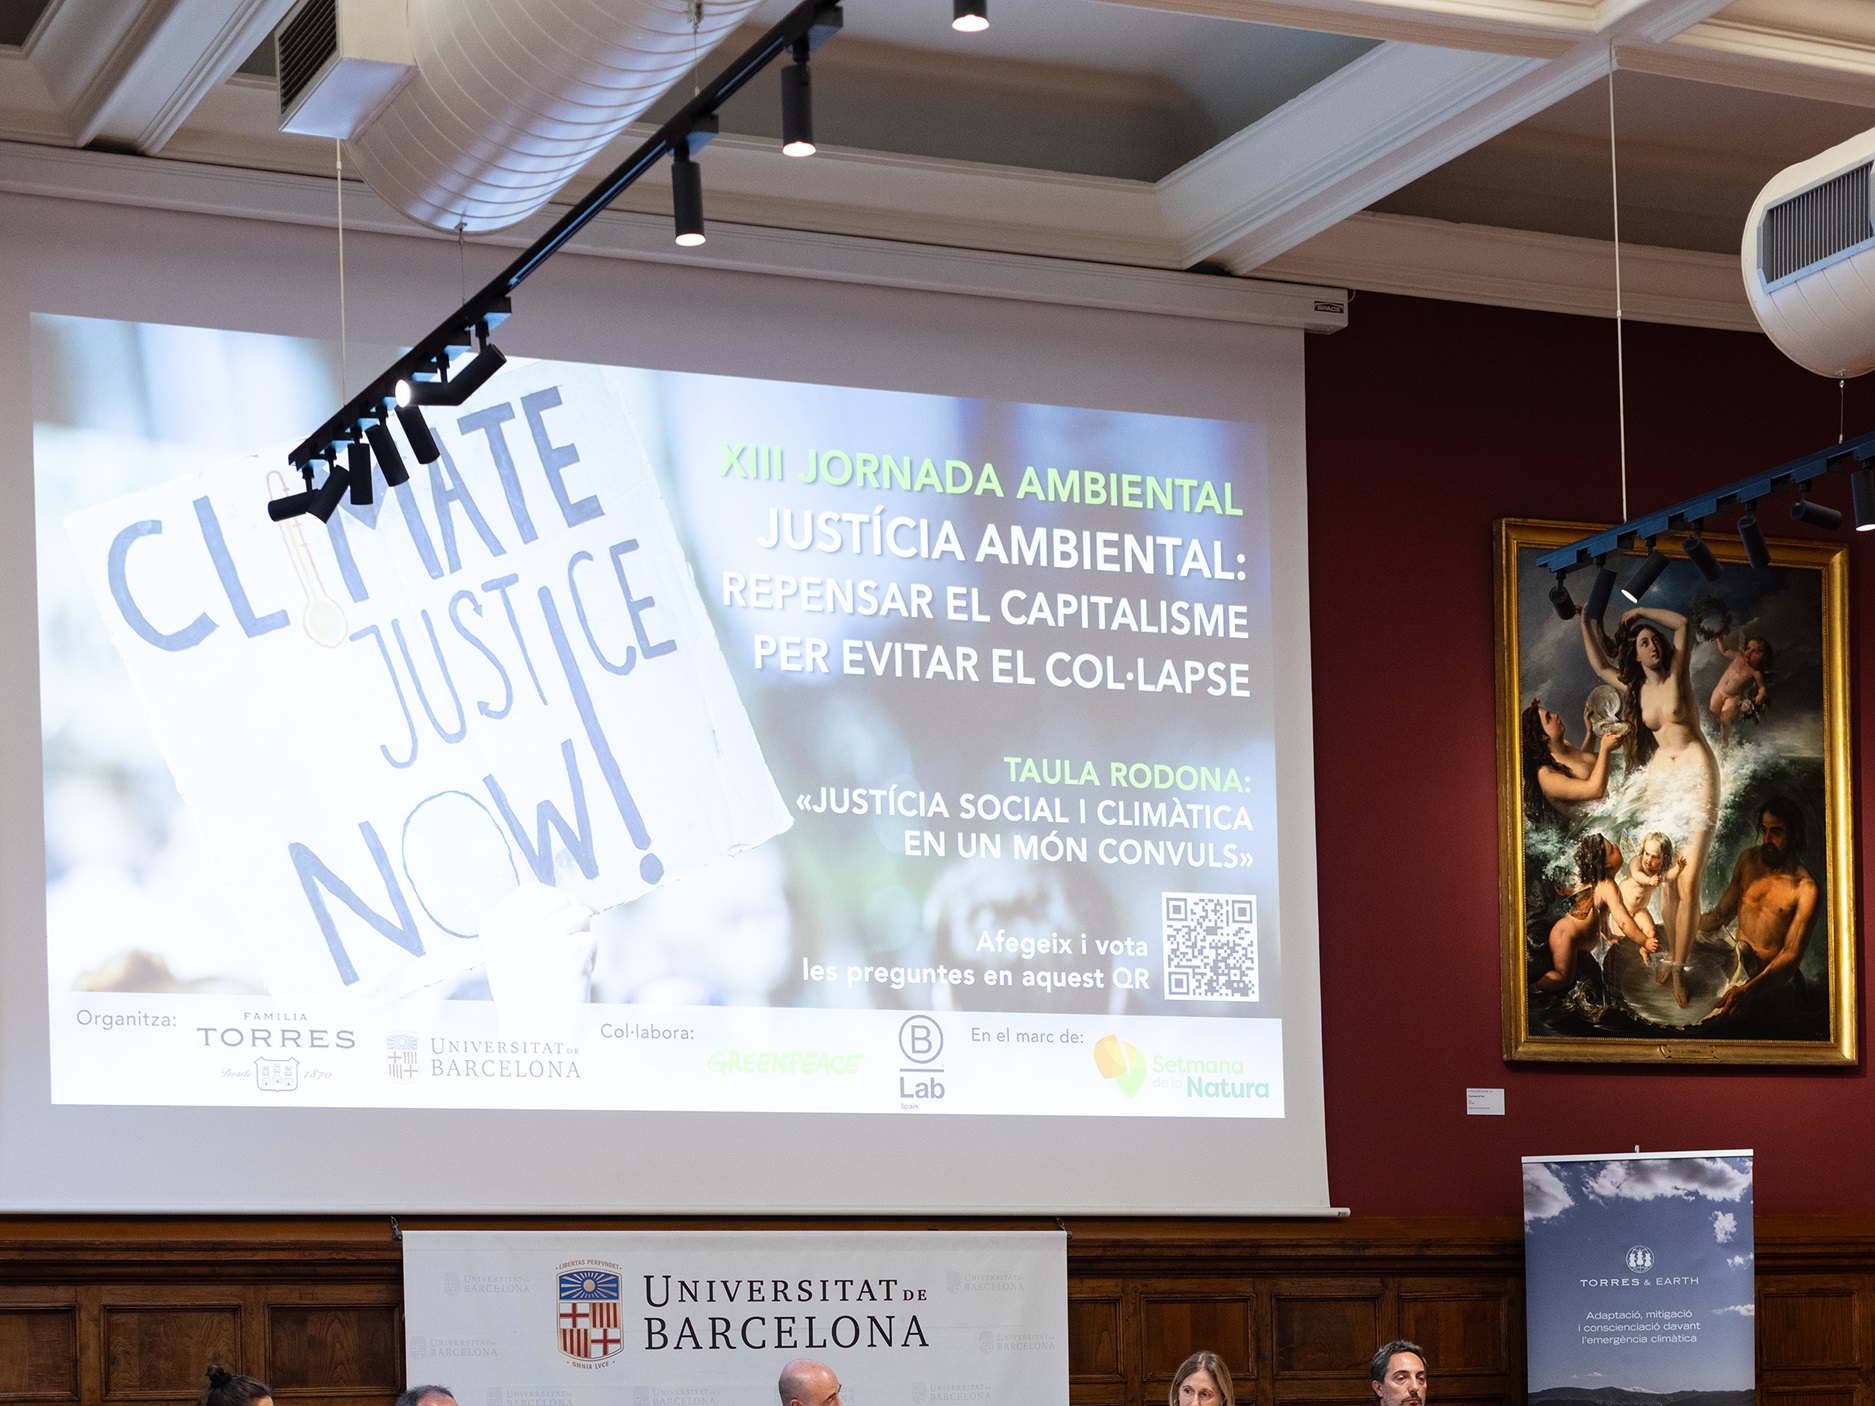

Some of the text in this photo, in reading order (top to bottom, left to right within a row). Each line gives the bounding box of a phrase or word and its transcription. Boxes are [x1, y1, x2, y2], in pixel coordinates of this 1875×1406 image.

[719, 441, 1244, 515] XIII JORNADA AMBIENTAL
[757, 505, 1246, 580] JUSTÍCIA AMBIENTAL:
[722, 571, 1249, 638] REPENSAR EL CAPITALISME
[349, 538, 678, 769] JUSTICE
[754, 634, 1250, 697] PER EVITAR EL COL·LAPSE
[1003, 756, 1252, 793] TAULA RODONA:
[796, 783, 1254, 831] «JUSTÍCIA SOCIAL I CLIMÀTICA
[904, 830, 1255, 869] EN UN MÓN CONVULS»
[976, 930, 1149, 960] Afegeix i vota
[802, 958, 1150, 993] les preguntes en aquest QR
[76, 1009, 177, 1031] Organitza:
[243, 1012, 308, 1021] FAMILIA
[196, 1027, 356, 1049] TORRES
[600, 1023, 695, 1040] Col·labora:
[911, 1025, 933, 1054] B
[971, 1027, 1084, 1044] En el marc de:
[430, 1037, 564, 1055] UNIVERSITAT
[302, 1069, 333, 1080] 1870
[430, 1059, 582, 1079] BARCELONA
[706, 1050, 866, 1077] GREENPEACE
[1152, 1055, 1245, 1074] Setmana
[899, 1076, 946, 1099] Lab
[1186, 1076, 1270, 1098] Natura
[558, 1260, 586, 1270] LIBERTAS
[464, 1284, 530, 1293] BARCELONA
[643, 1275, 928, 1308] UNIVERSITAT DE
[1580, 1279, 1640, 1287] TORRES
[1656, 1277, 1699, 1286] EARTH
[1586, 1309, 1693, 1321] Adaptació, mitigació
[644, 1315, 929, 1350] BARCELONA
[1583, 1322, 1660, 1333] conscienciació
[1663, 1321, 1701, 1331] davant
[1581, 1334, 1698, 1346] l'emergència climàtica
[430, 1348, 499, 1357] BARCELONA
[572, 1361, 593, 1370] OMNIA
[652, 1397, 716, 1406] BARCELONA
[930, 1392, 992, 1401] BARCELONA
